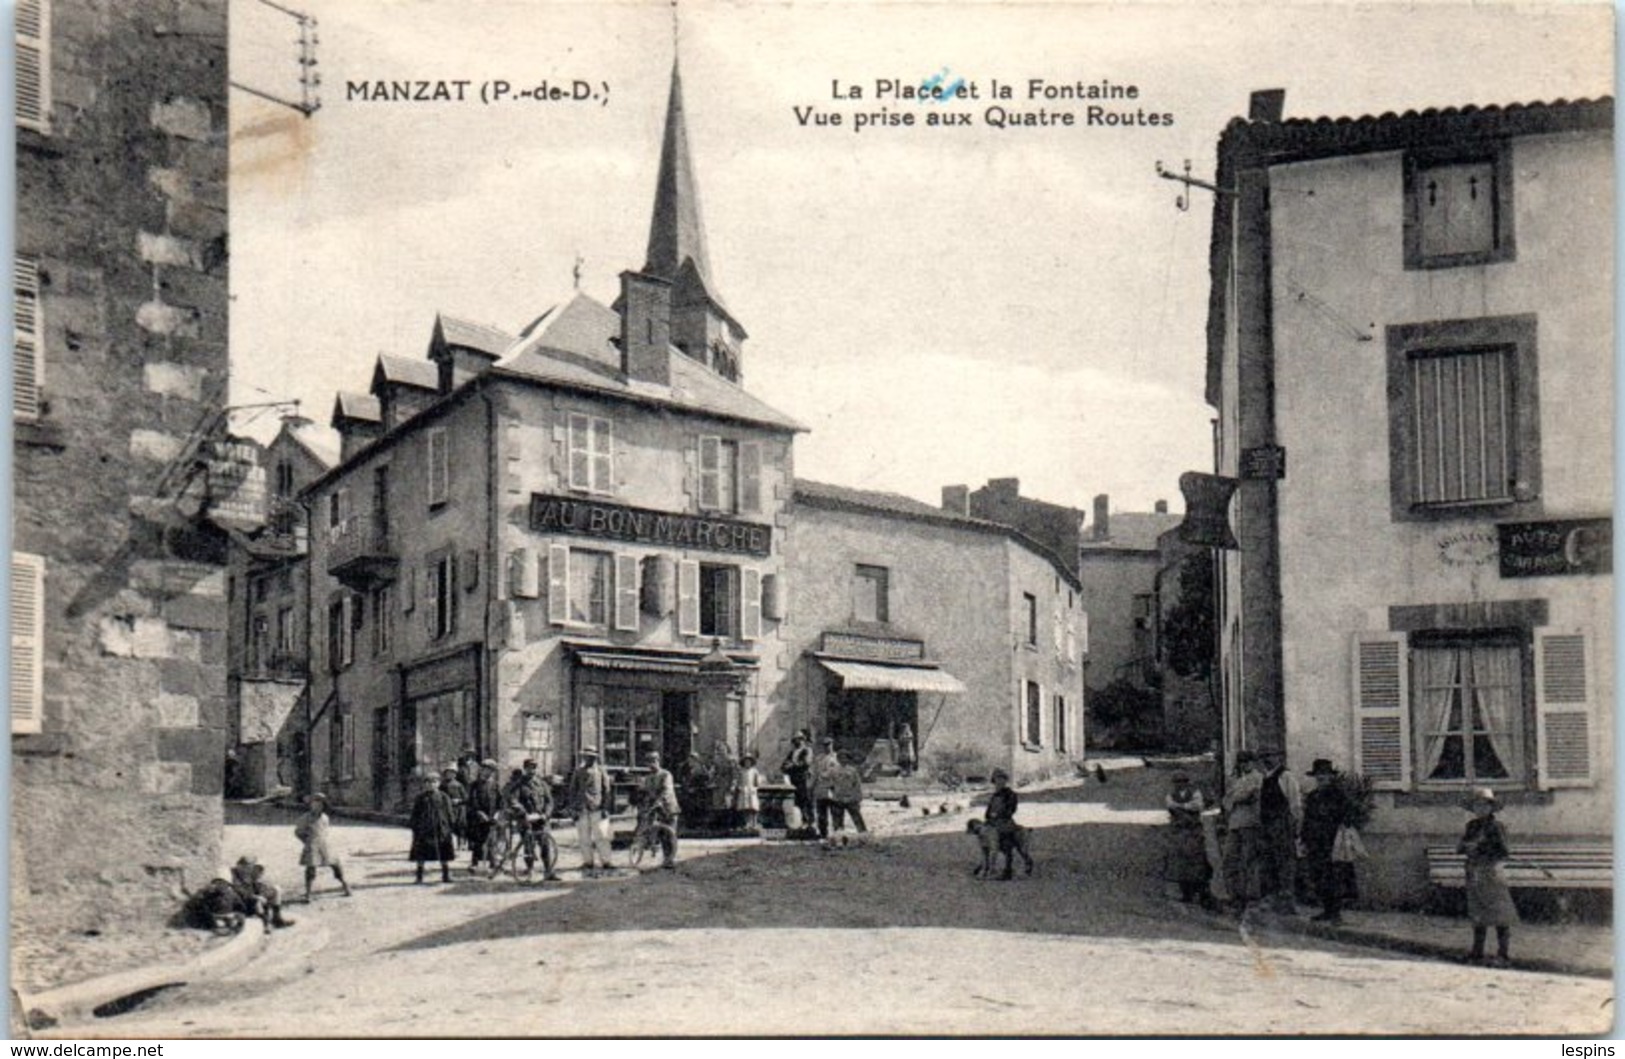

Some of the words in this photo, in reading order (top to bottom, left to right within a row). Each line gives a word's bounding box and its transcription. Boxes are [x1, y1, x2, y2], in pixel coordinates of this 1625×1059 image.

[541, 502, 578, 527] AU
[589, 507, 643, 534] BON
[653, 516, 763, 550] MARCHE
